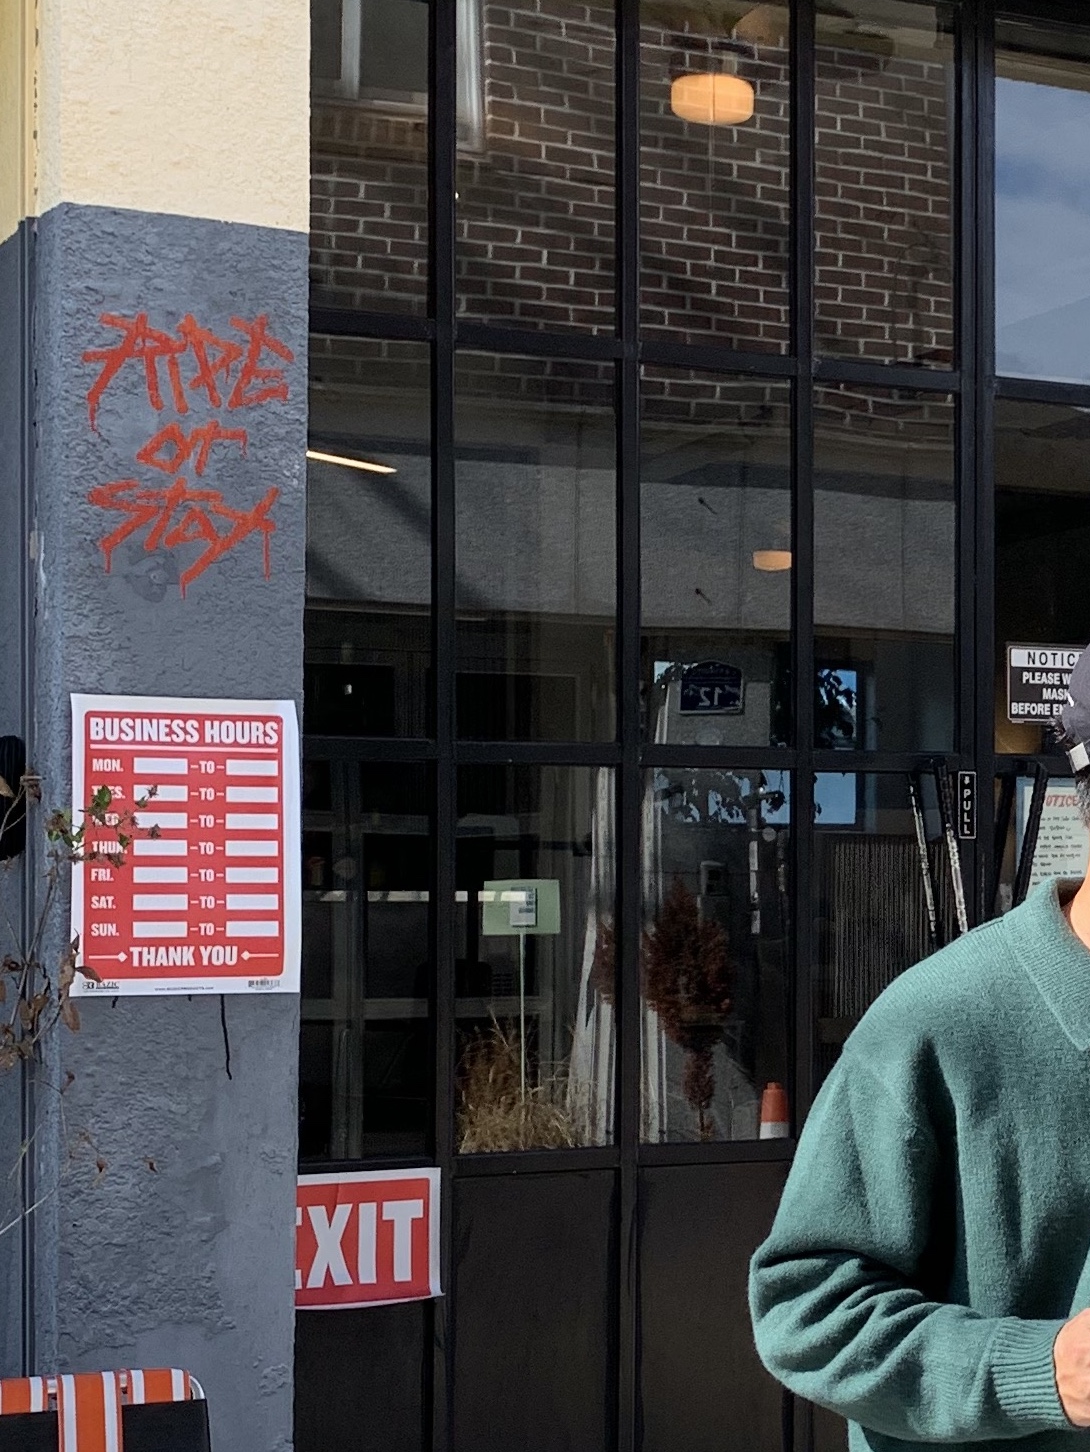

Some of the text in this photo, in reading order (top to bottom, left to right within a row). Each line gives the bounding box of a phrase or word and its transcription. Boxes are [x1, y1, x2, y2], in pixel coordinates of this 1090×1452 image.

[1027, 651, 1081, 667] NOTIC
[1022, 671, 1061, 685] PLEASE
[1011, 702, 1051, 715] BEFORE
[89, 716, 279, 745] BUSINESS HOURS
[92, 758, 124, 772] MON.
[91, 785, 126, 799] TES.
[1045, 794, 1079, 808] OTICE
[962, 788, 972, 835] PULL
[91, 868, 114, 882] FRI.
[91, 896, 117, 909] SAT.
[91, 923, 119, 937] SUN.
[129, 945, 238, 967] THANK YOU
